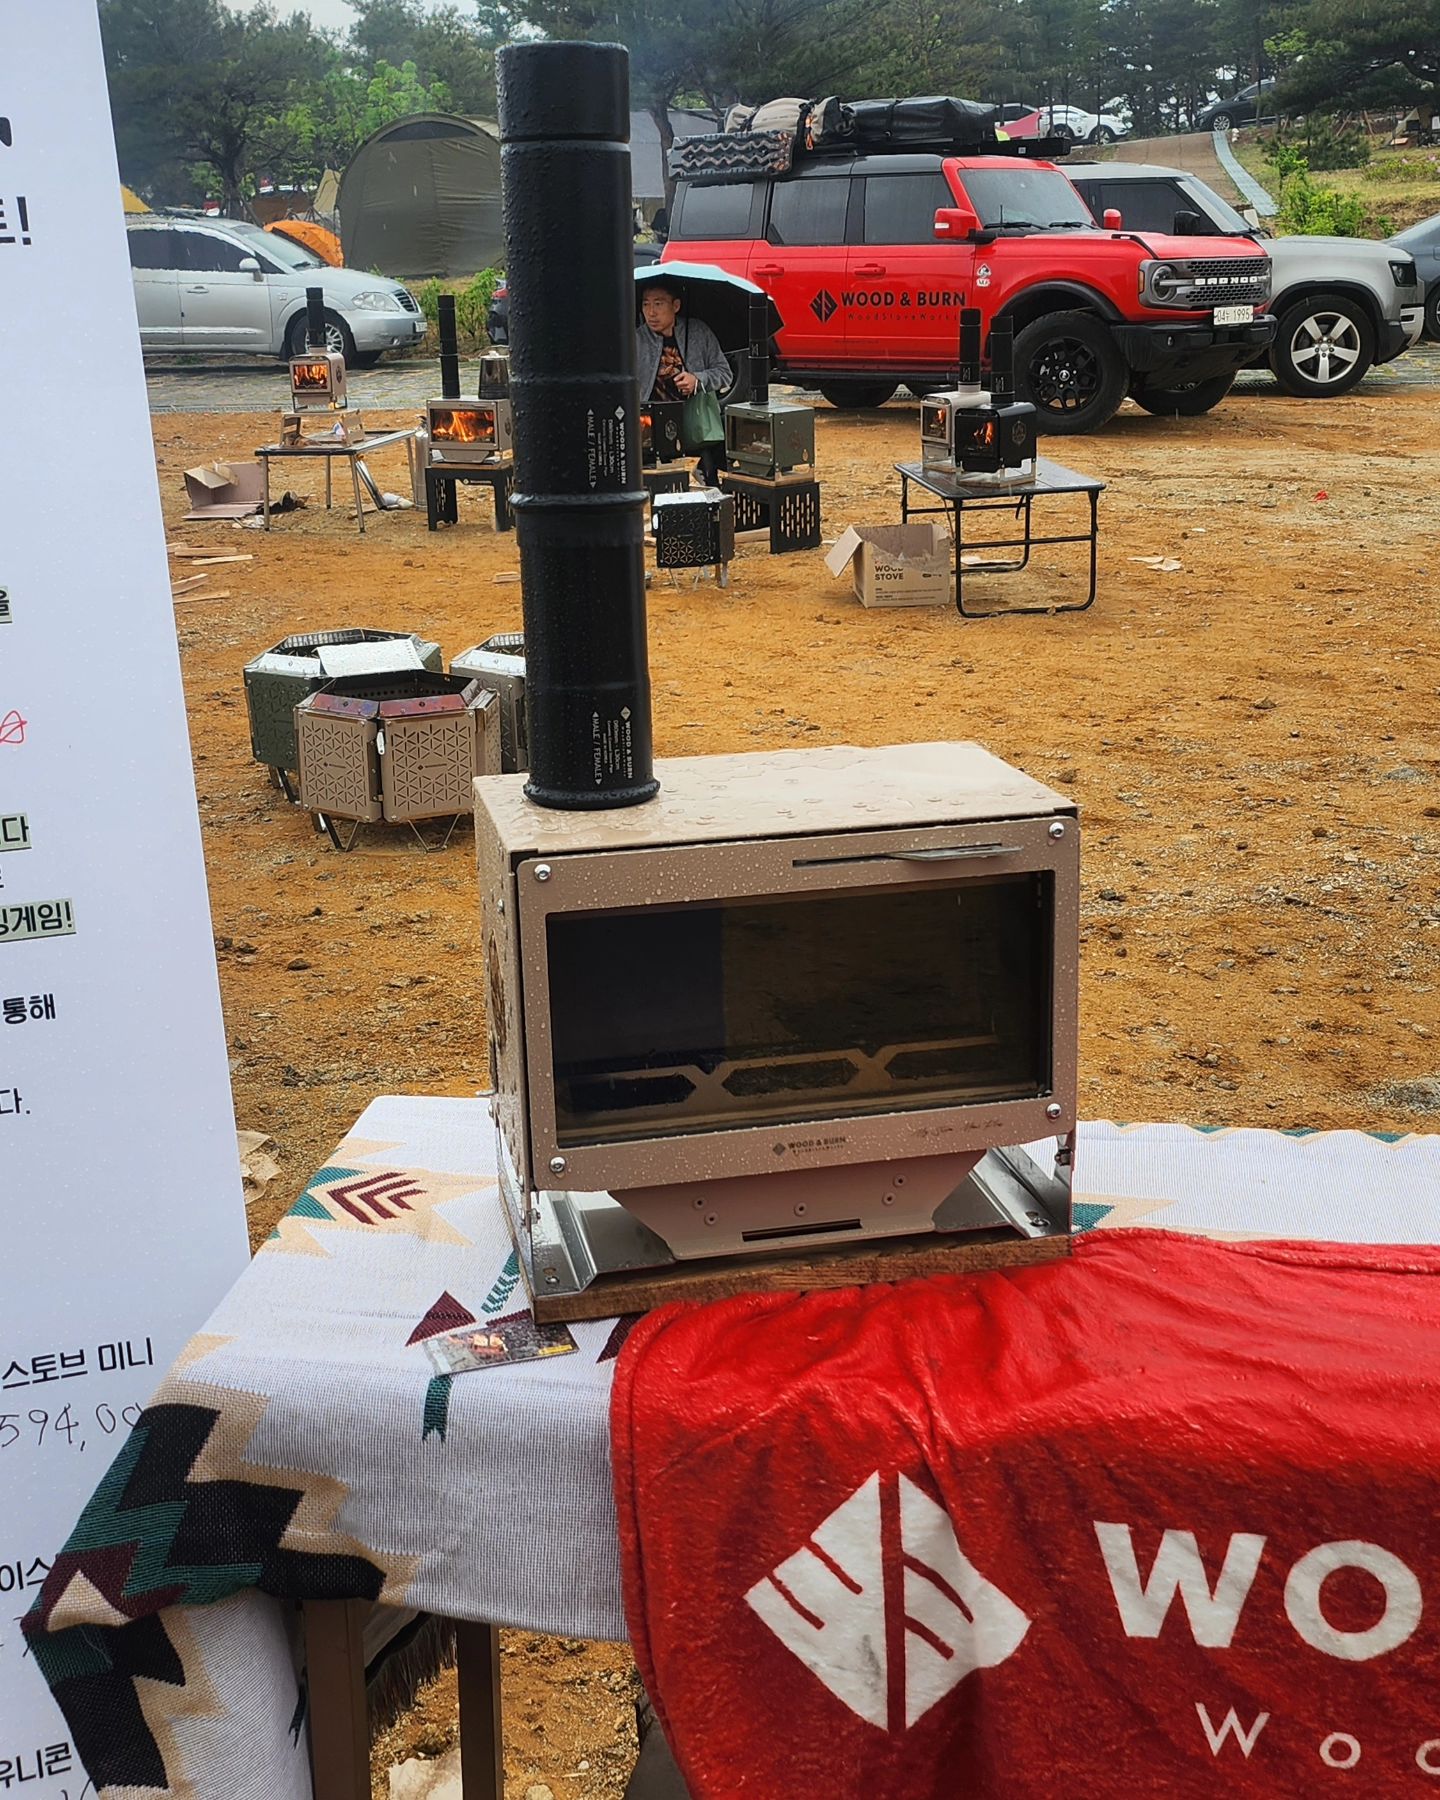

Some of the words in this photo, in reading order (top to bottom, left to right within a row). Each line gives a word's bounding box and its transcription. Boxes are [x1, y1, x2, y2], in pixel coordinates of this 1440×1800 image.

[841, 291, 894, 307] WOOD
[900, 292, 912, 307] &
[917, 291, 966, 307] BURN
[587, 416, 596, 439] MALE
[588, 448, 597, 481] FEMALE
[875, 573, 904, 581] STOVE
[592, 718, 601, 740] MALE
[593, 747, 603, 778] FEMALE
[3, 993, 56, 1025] 통해
[787, 1139, 815, 1149] WOOD
[823, 1136, 846, 1145] BURN
[2, 1348, 88, 1389] 스토브
[98, 1336, 154, 1372] 미니
